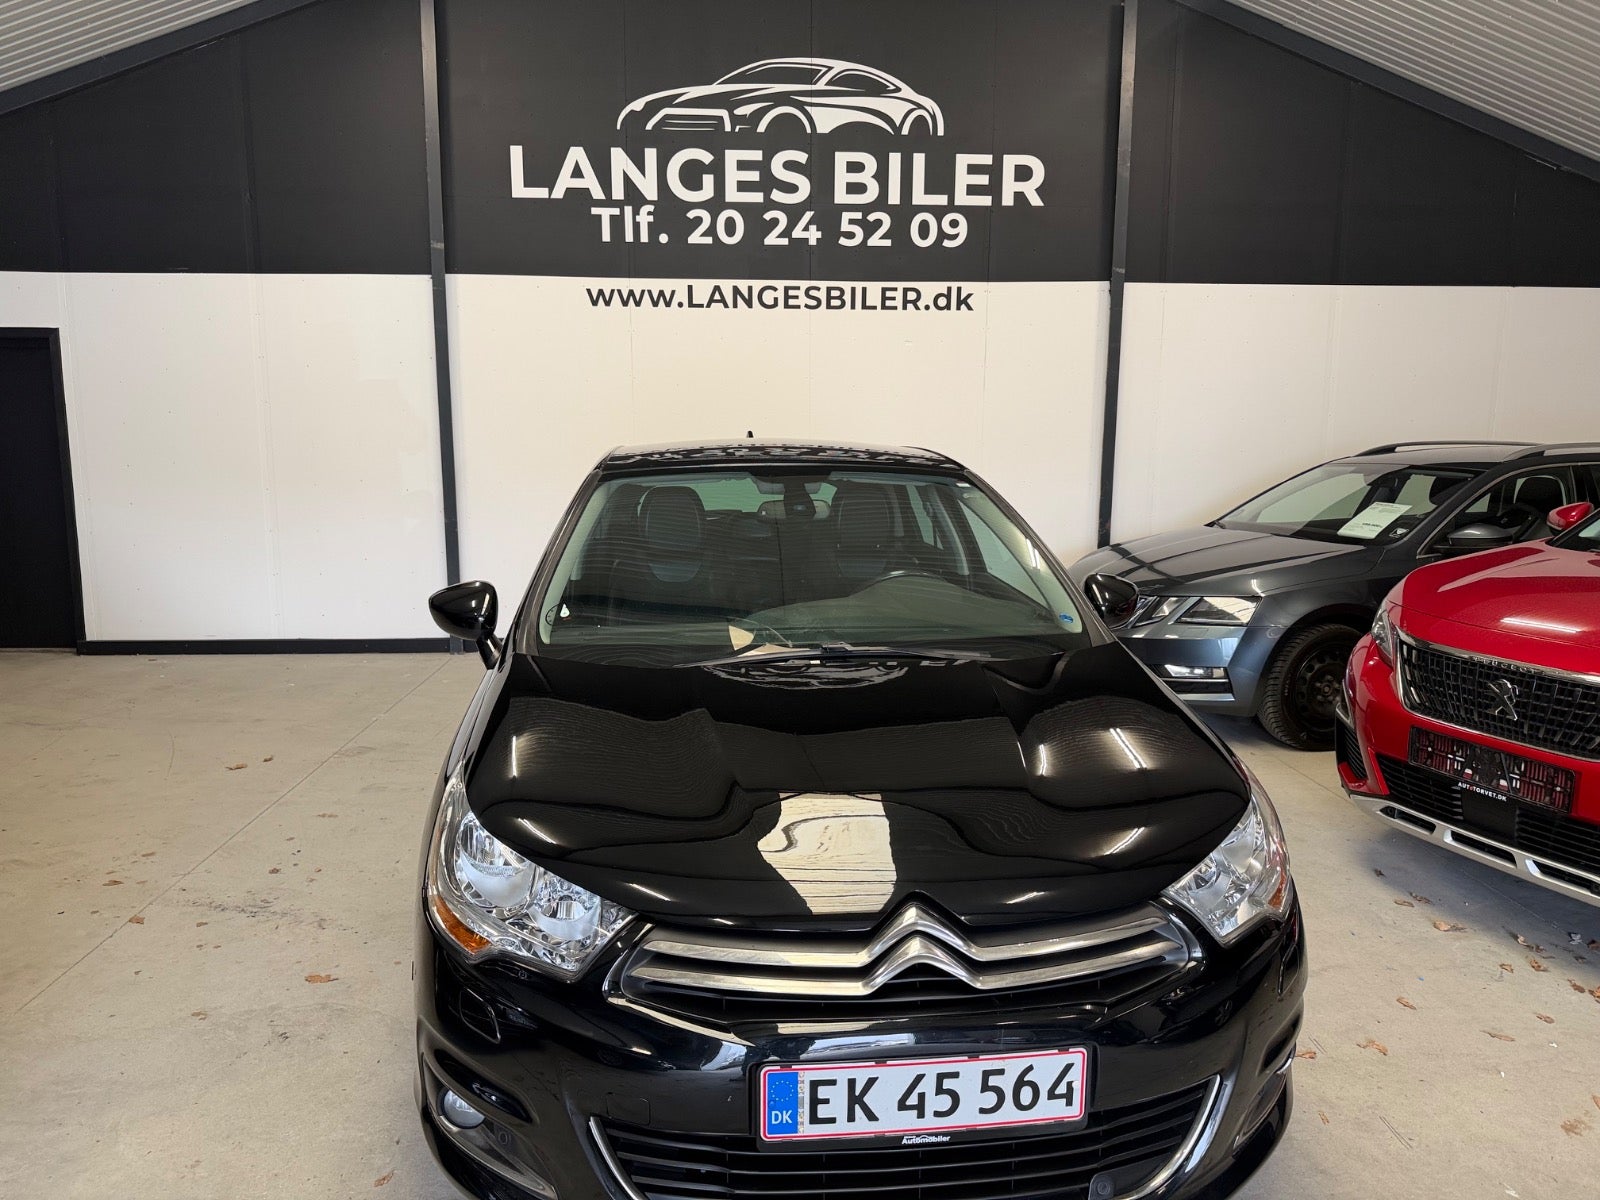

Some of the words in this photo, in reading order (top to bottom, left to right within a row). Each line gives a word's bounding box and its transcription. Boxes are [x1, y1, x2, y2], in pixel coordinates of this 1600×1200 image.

[510, 145, 811, 205] LANGES
[834, 151, 1045, 207] BILER
[590, 204, 669, 243] Tlf.
[686, 208, 745, 245] 20
[762, 209, 822, 246] 24
[838, 211, 892, 247] 52
[909, 212, 968, 248] 09
[586, 284, 974, 311] www.LANGESBILER.dk
[808, 1076, 880, 1125] EK
[897, 1071, 961, 1120] 45
[978, 1062, 1075, 1115] 564
[771, 1110, 793, 1125] DK
